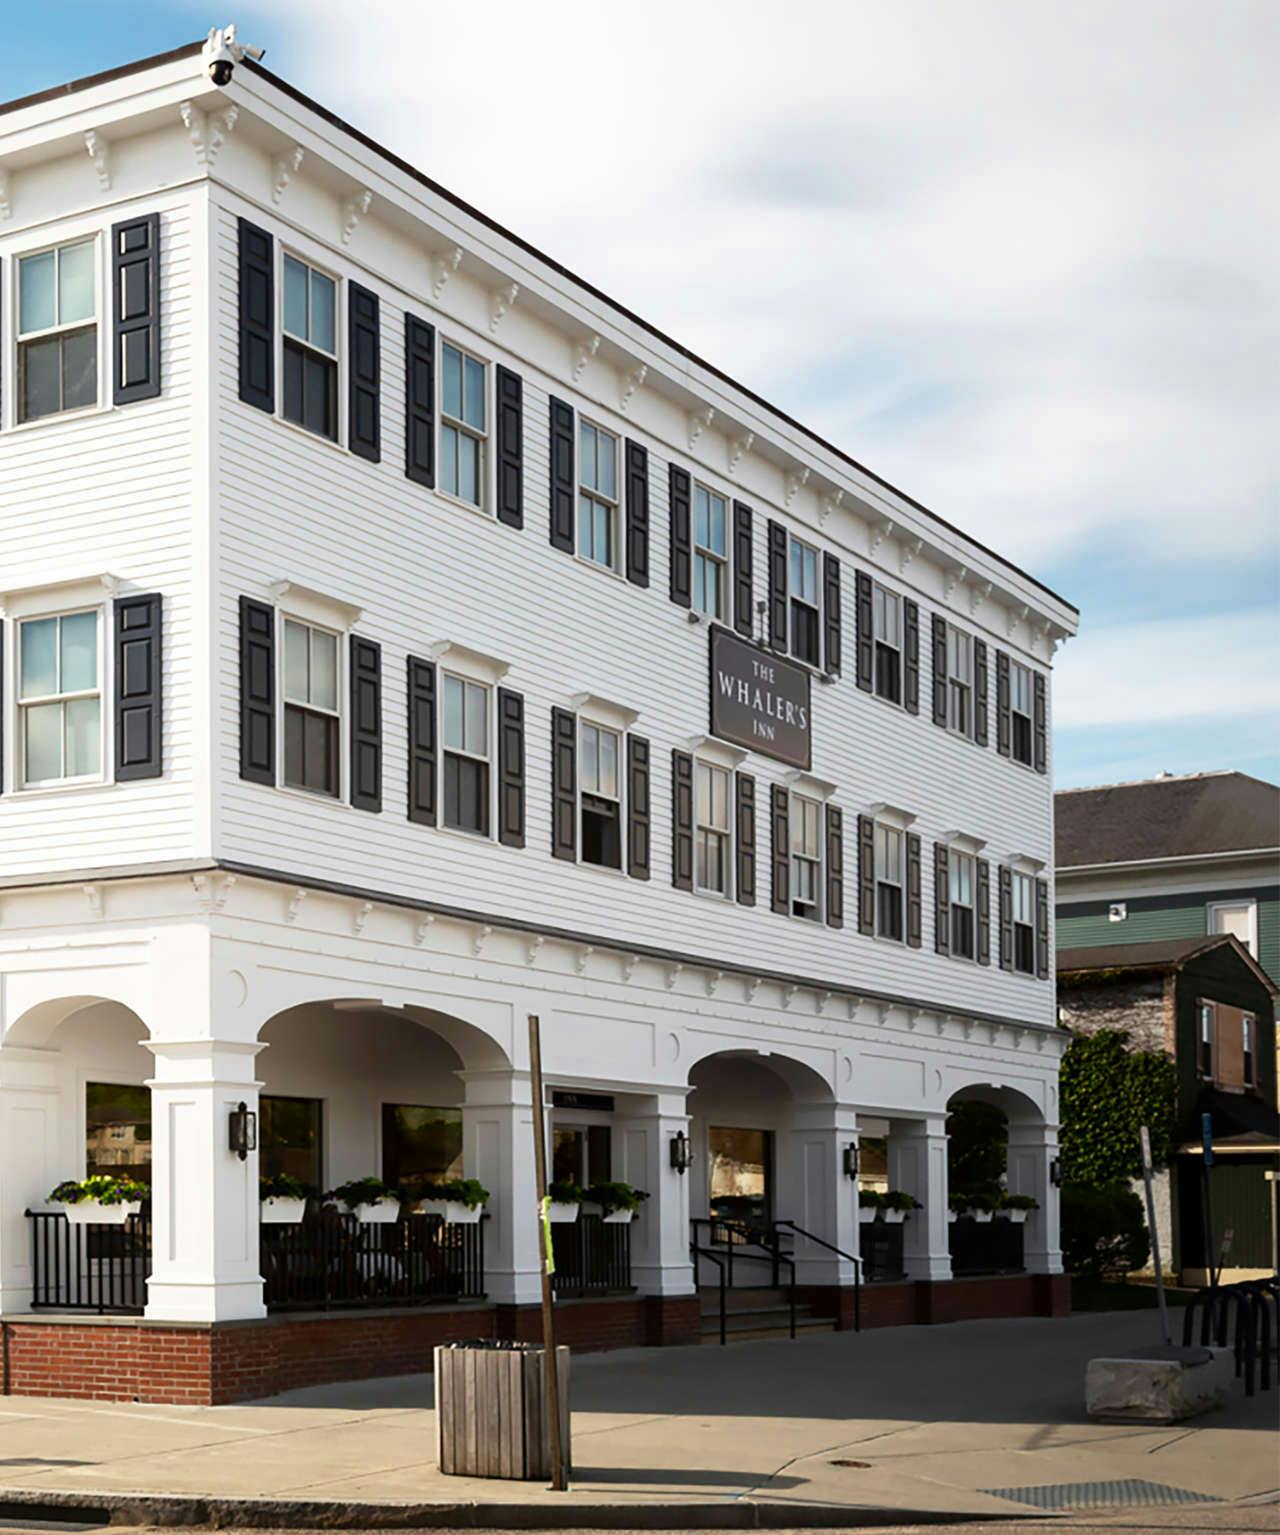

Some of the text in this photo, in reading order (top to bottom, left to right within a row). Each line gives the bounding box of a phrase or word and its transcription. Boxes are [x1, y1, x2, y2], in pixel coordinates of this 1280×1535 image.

[752, 660, 775, 684] THE
[718, 671, 808, 730] WHALER'S
[752, 719, 775, 741] INN
